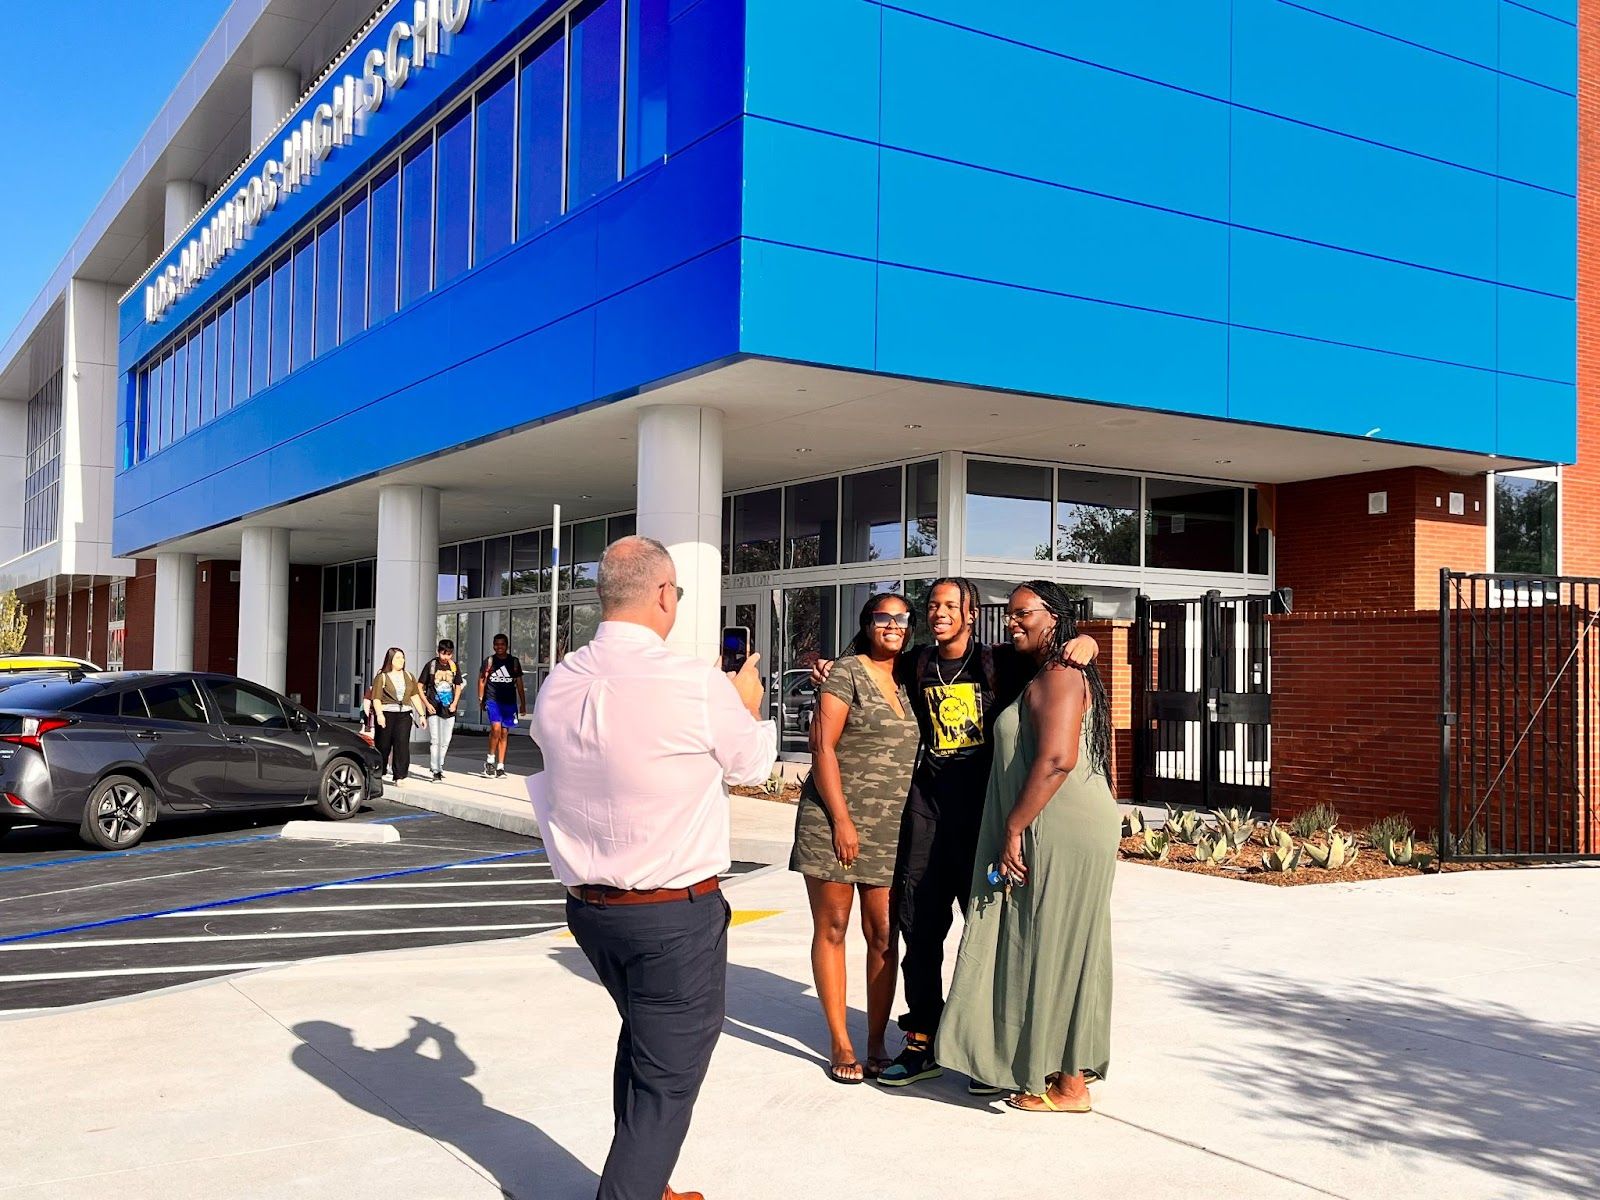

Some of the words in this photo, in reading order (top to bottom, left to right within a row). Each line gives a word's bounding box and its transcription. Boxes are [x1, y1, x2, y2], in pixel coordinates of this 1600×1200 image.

[146, 265, 177, 324] LOS
[176, 160, 279, 295] ALAMITOS
[283, 74, 354, 193] HIGH
